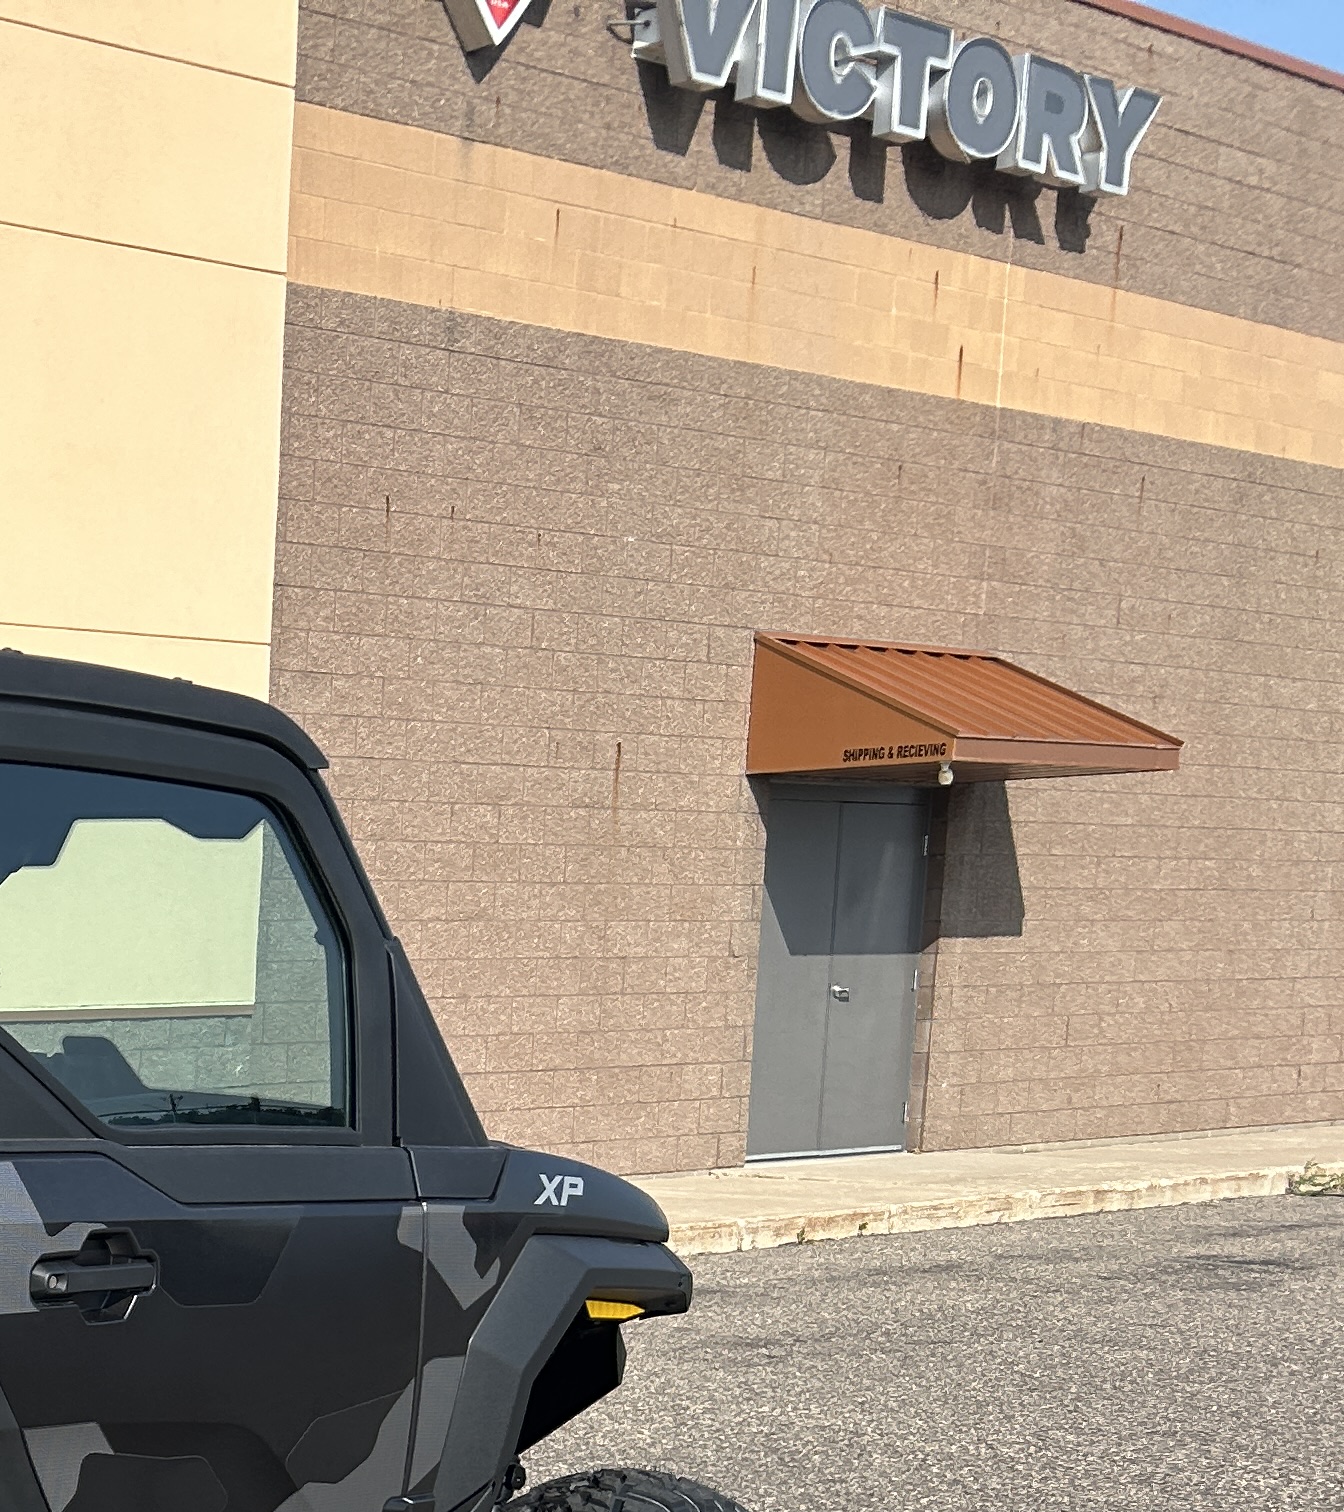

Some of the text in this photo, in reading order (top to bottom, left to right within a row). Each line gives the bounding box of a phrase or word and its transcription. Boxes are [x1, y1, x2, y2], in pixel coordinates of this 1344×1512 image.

[674, 0, 1163, 196] VICTORY
[843, 743, 947, 762] SHIPPING & RECIEVING
[533, 1173, 585, 1207] XP
